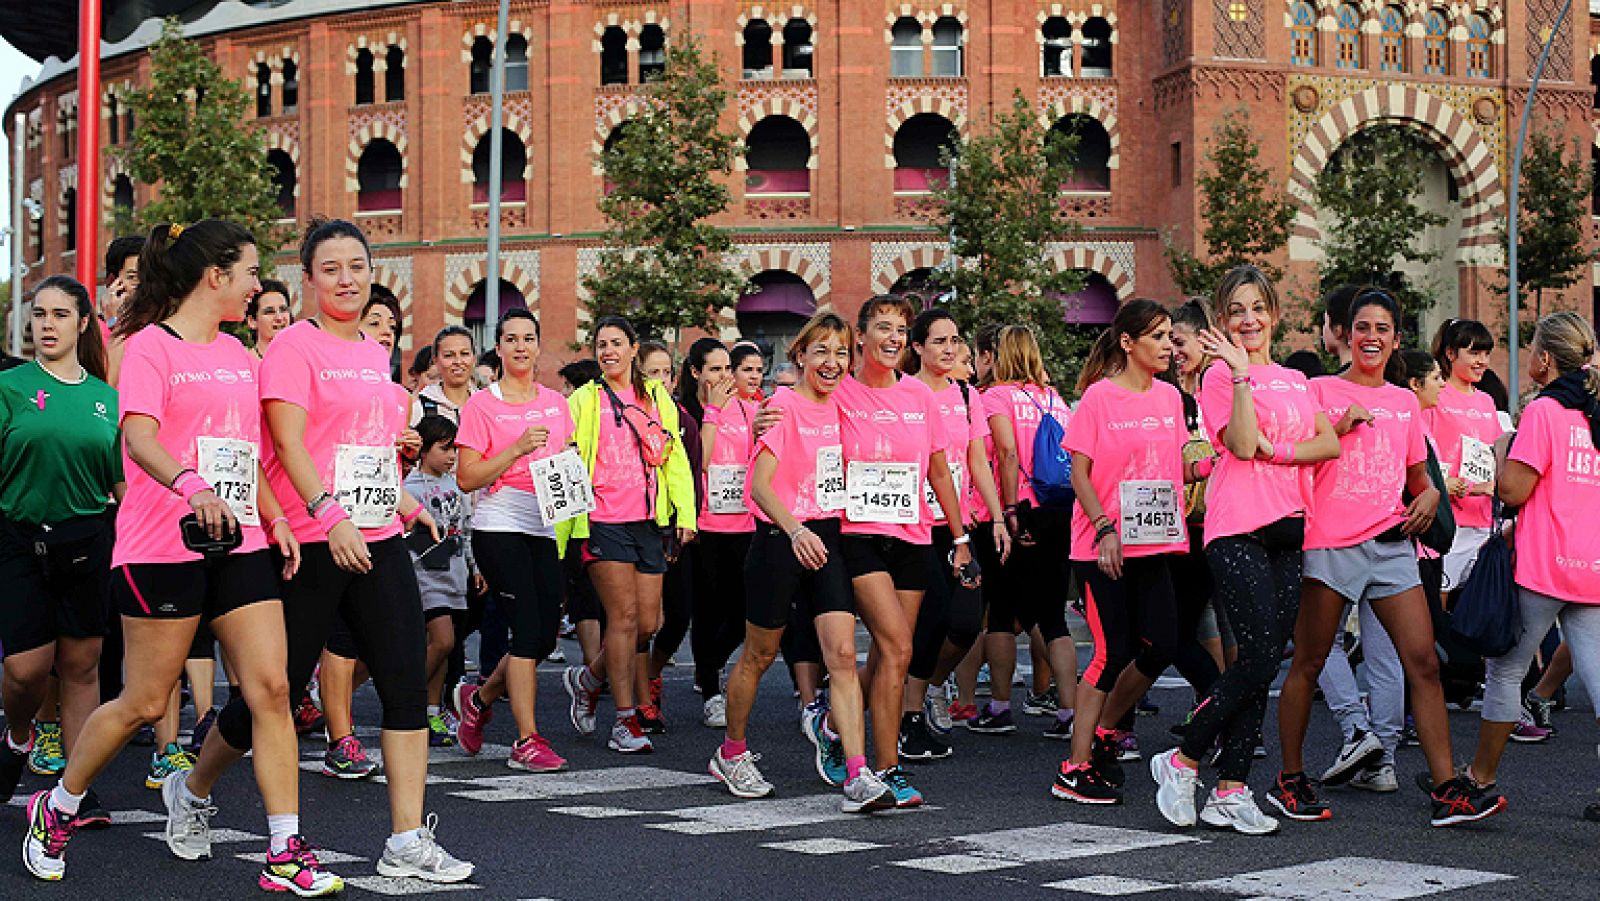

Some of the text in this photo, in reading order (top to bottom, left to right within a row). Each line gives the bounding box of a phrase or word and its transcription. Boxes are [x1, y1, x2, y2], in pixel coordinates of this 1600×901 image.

[1567, 451, 1591, 474] LAS
[861, 491, 911, 508] 14576
[1135, 512, 1176, 527] 14673
